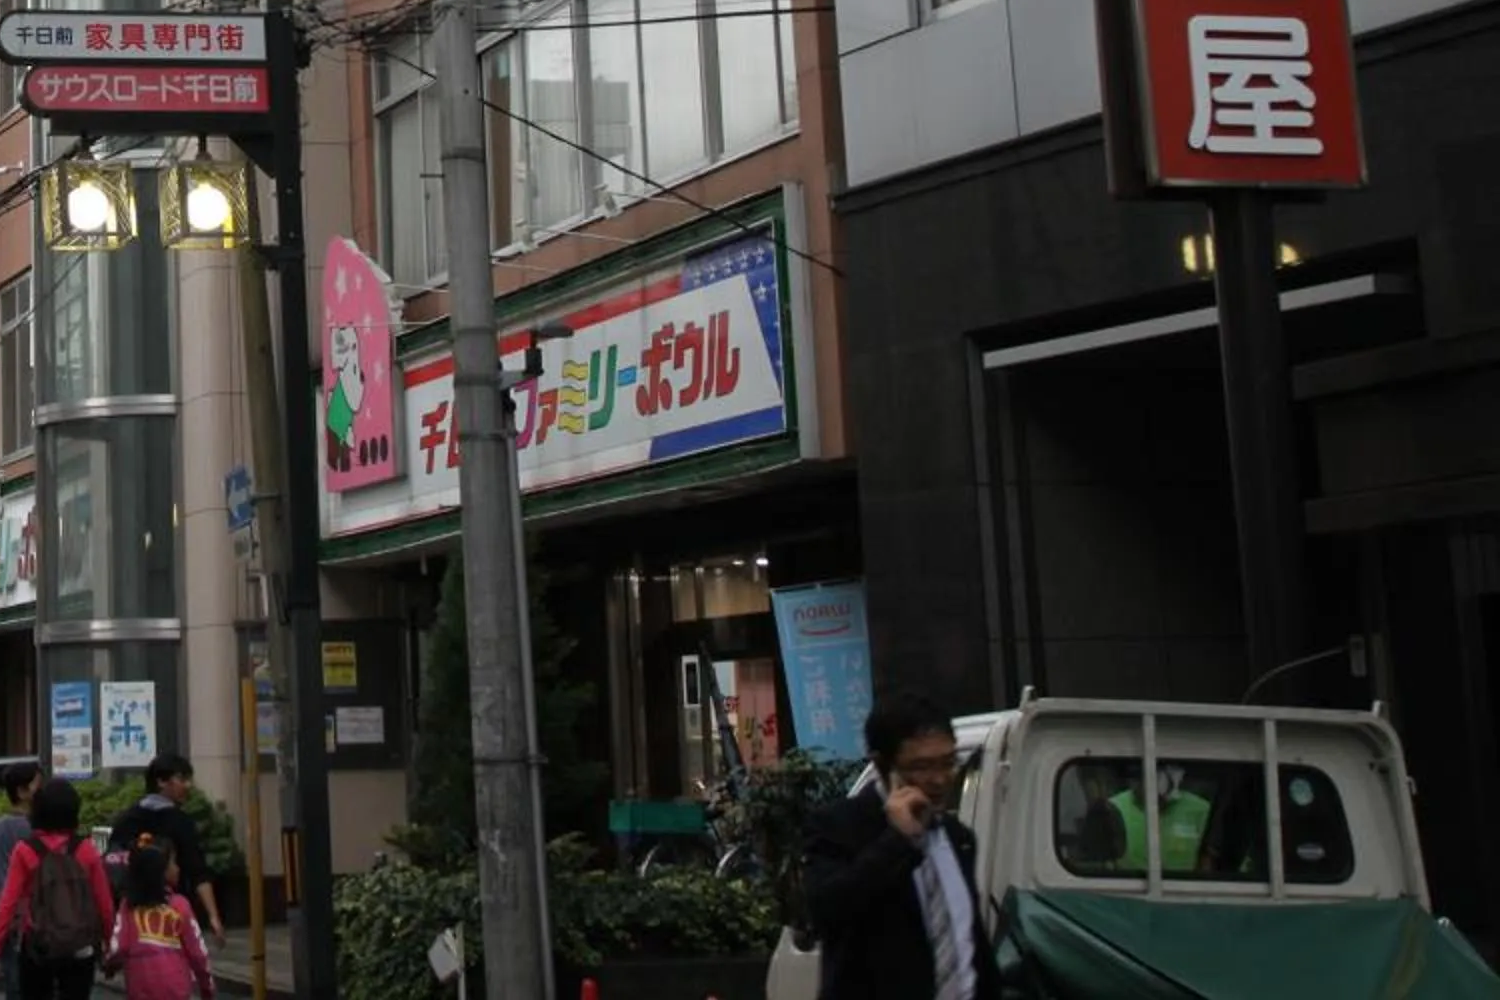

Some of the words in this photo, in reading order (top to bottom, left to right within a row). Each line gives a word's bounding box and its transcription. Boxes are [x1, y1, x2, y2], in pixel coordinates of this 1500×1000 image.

[16, 26, 74, 46] 千日前
[85, 23, 245, 52] 家具専門街
[37, 73, 259, 104] サウスロード千日前
